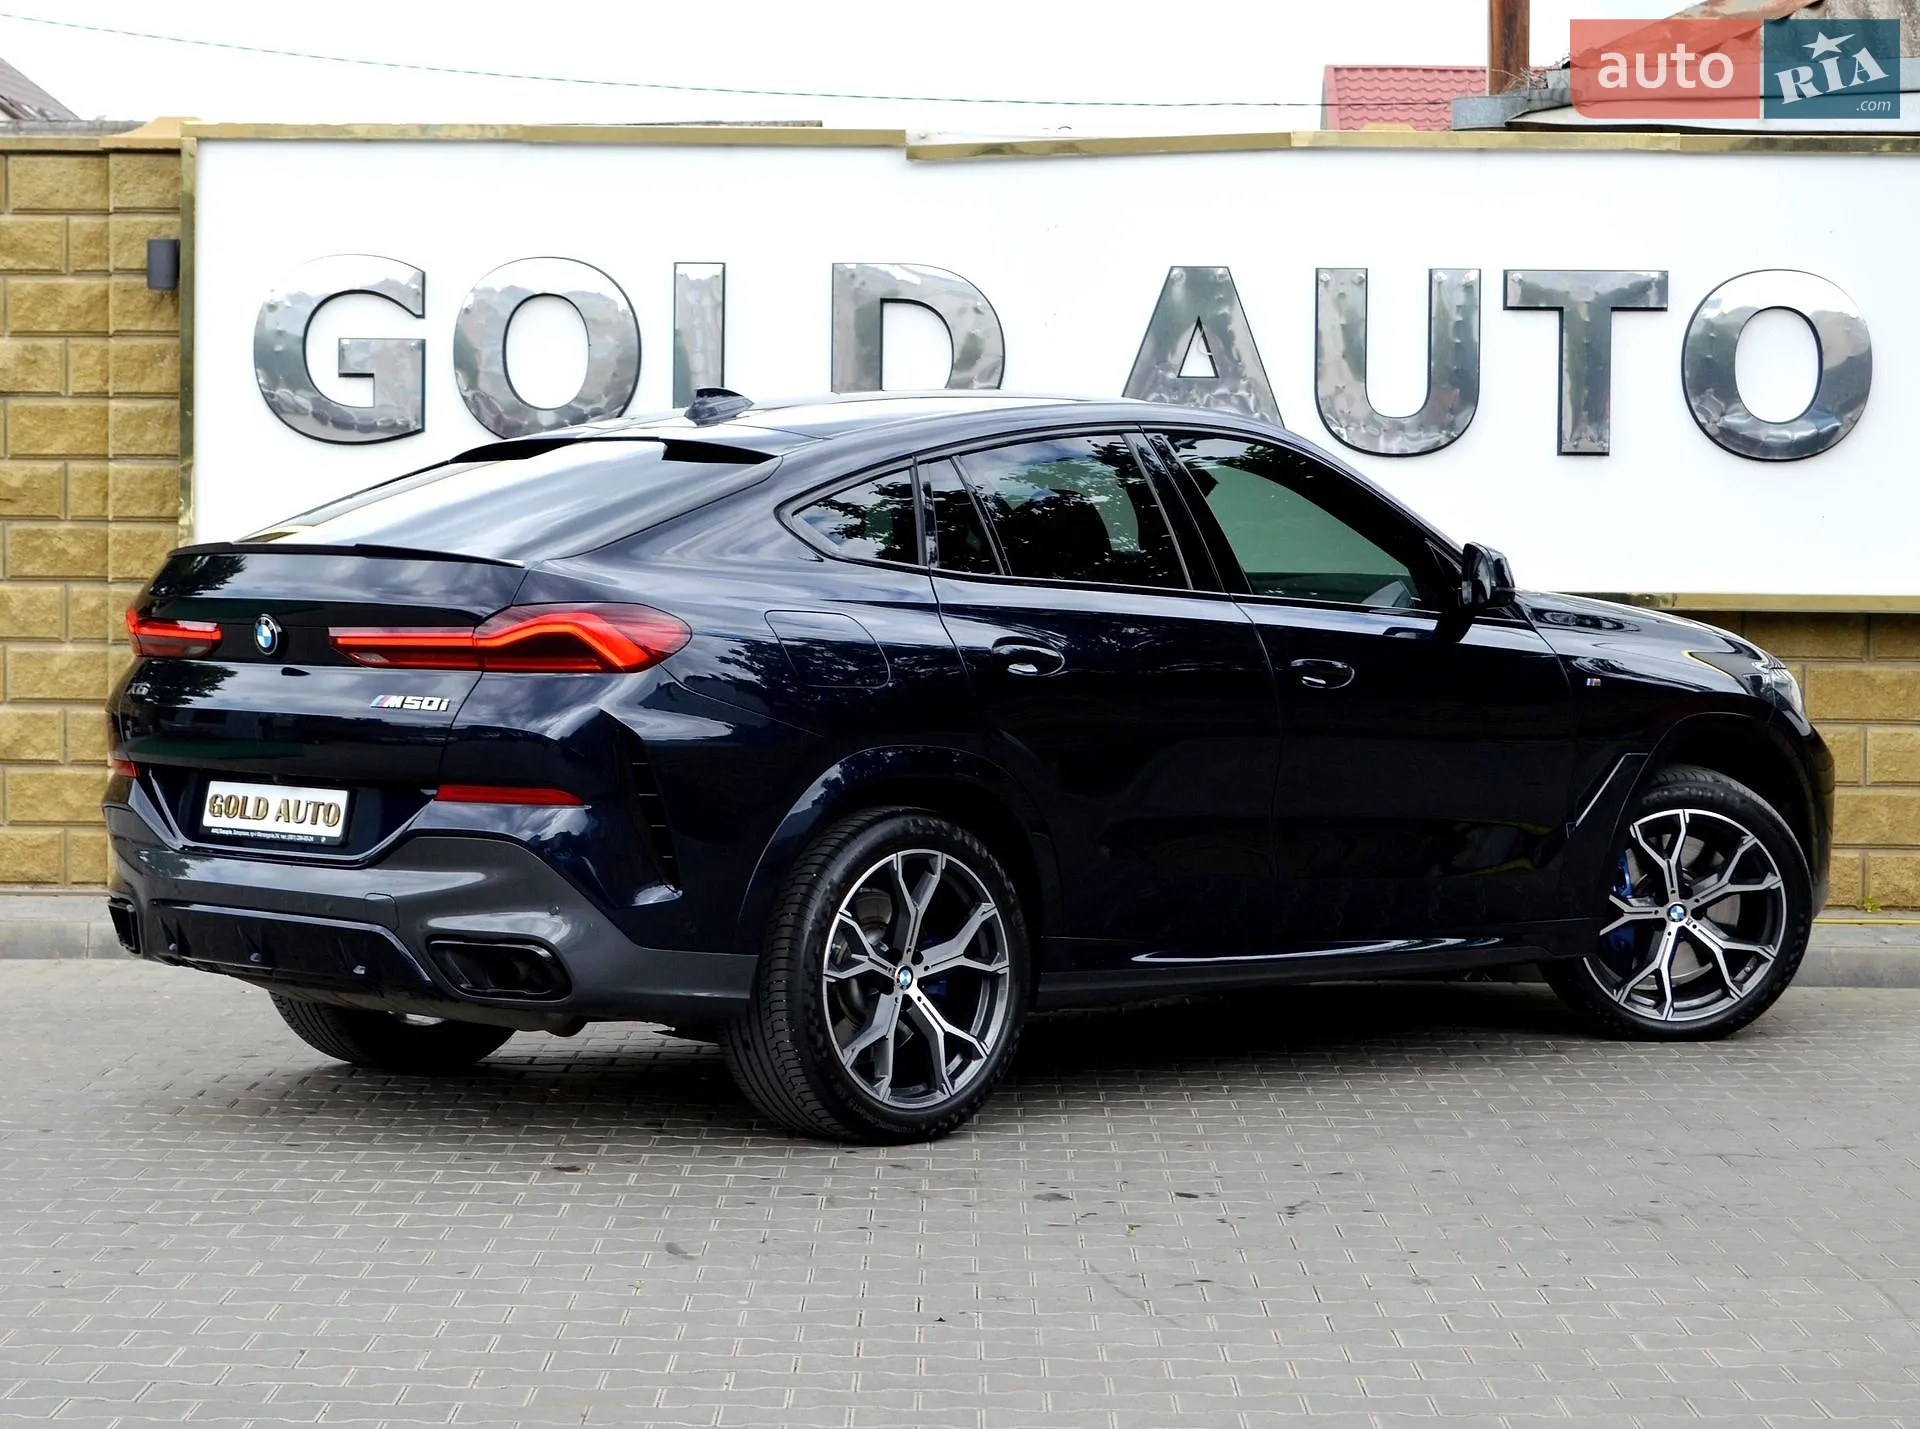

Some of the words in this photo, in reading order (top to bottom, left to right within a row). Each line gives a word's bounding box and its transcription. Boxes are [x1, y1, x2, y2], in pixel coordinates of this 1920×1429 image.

[1122, 265, 1873, 462] AUTO
[381, 695, 450, 712] M50i
[208, 793, 270, 821] GOLD
[274, 798, 341, 828] AUTO
